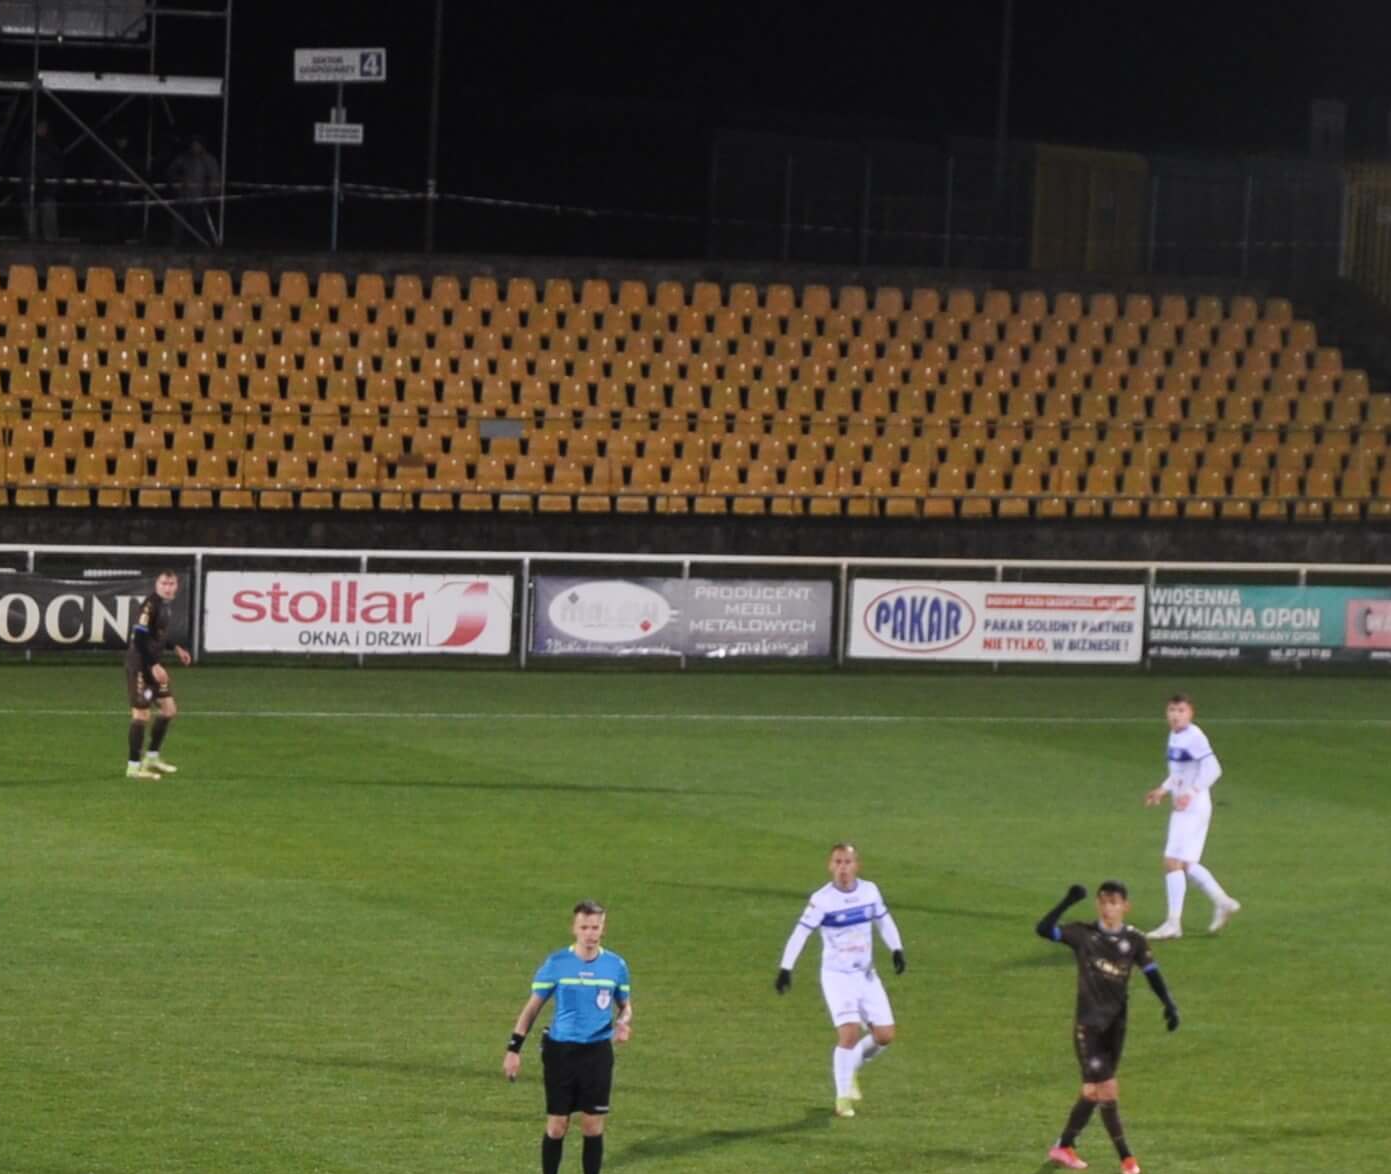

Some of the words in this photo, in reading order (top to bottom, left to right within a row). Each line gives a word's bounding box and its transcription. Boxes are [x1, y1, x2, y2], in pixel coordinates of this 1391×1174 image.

[362, 52, 379, 76] 4
[695, 586, 813, 600] PRODUCENT
[1149, 588, 1241, 605] WIOSENNA
[231, 580, 425, 624] stollar
[725, 602, 782, 616] MEBLI
[689, 619, 816, 632] METALOWYCH
[875, 597, 962, 643] PAKAR
[1149, 607, 1256, 627] WYMIANA
[1261, 608, 1321, 628] OPON
[983, 619, 1024, 632] PAKAR
[1027, 620, 1077, 633] SOLIDNY
[1081, 621, 1134, 634] PARTNER
[298, 630, 350, 646] OKNA
[365, 631, 422, 647] DRZWI
[982, 638, 1002, 650] NIE
[1053, 640, 1065, 651] W
[1068, 640, 1121, 652] BIZNESIE
